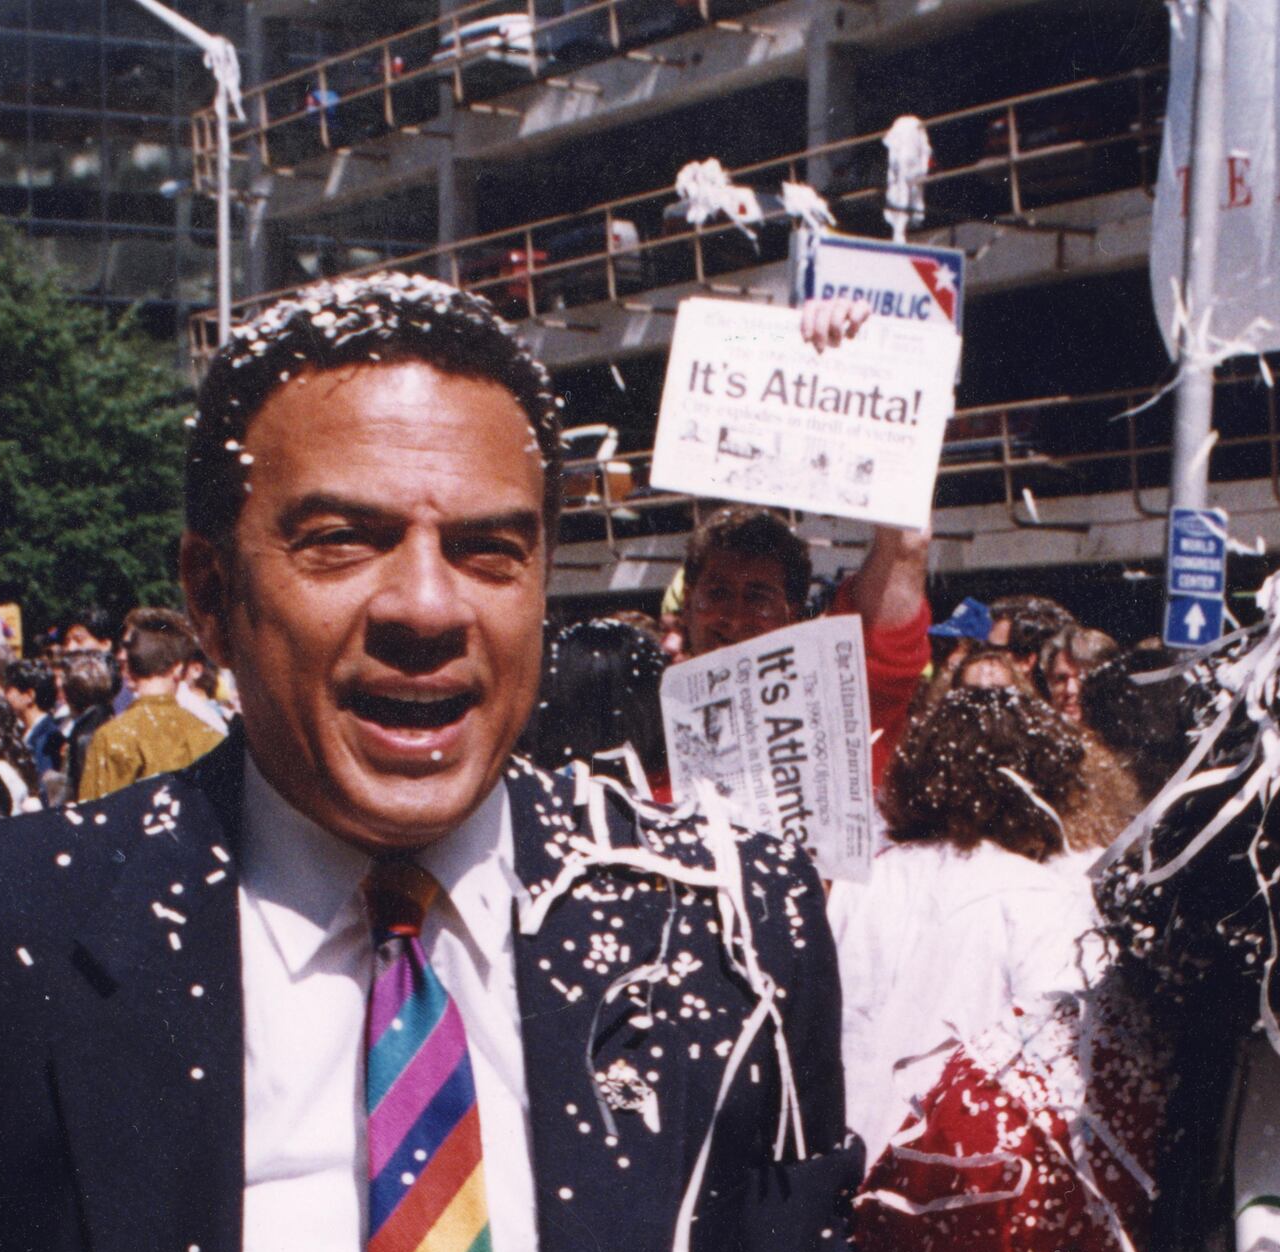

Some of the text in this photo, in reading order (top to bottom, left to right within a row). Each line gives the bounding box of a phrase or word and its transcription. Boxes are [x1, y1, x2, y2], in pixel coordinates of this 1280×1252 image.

[1175, 155, 1252, 218] TE
[688, 359, 748, 399] It's
[760, 367, 923, 427] Atlanta!
[757, 646, 798, 705] It's
